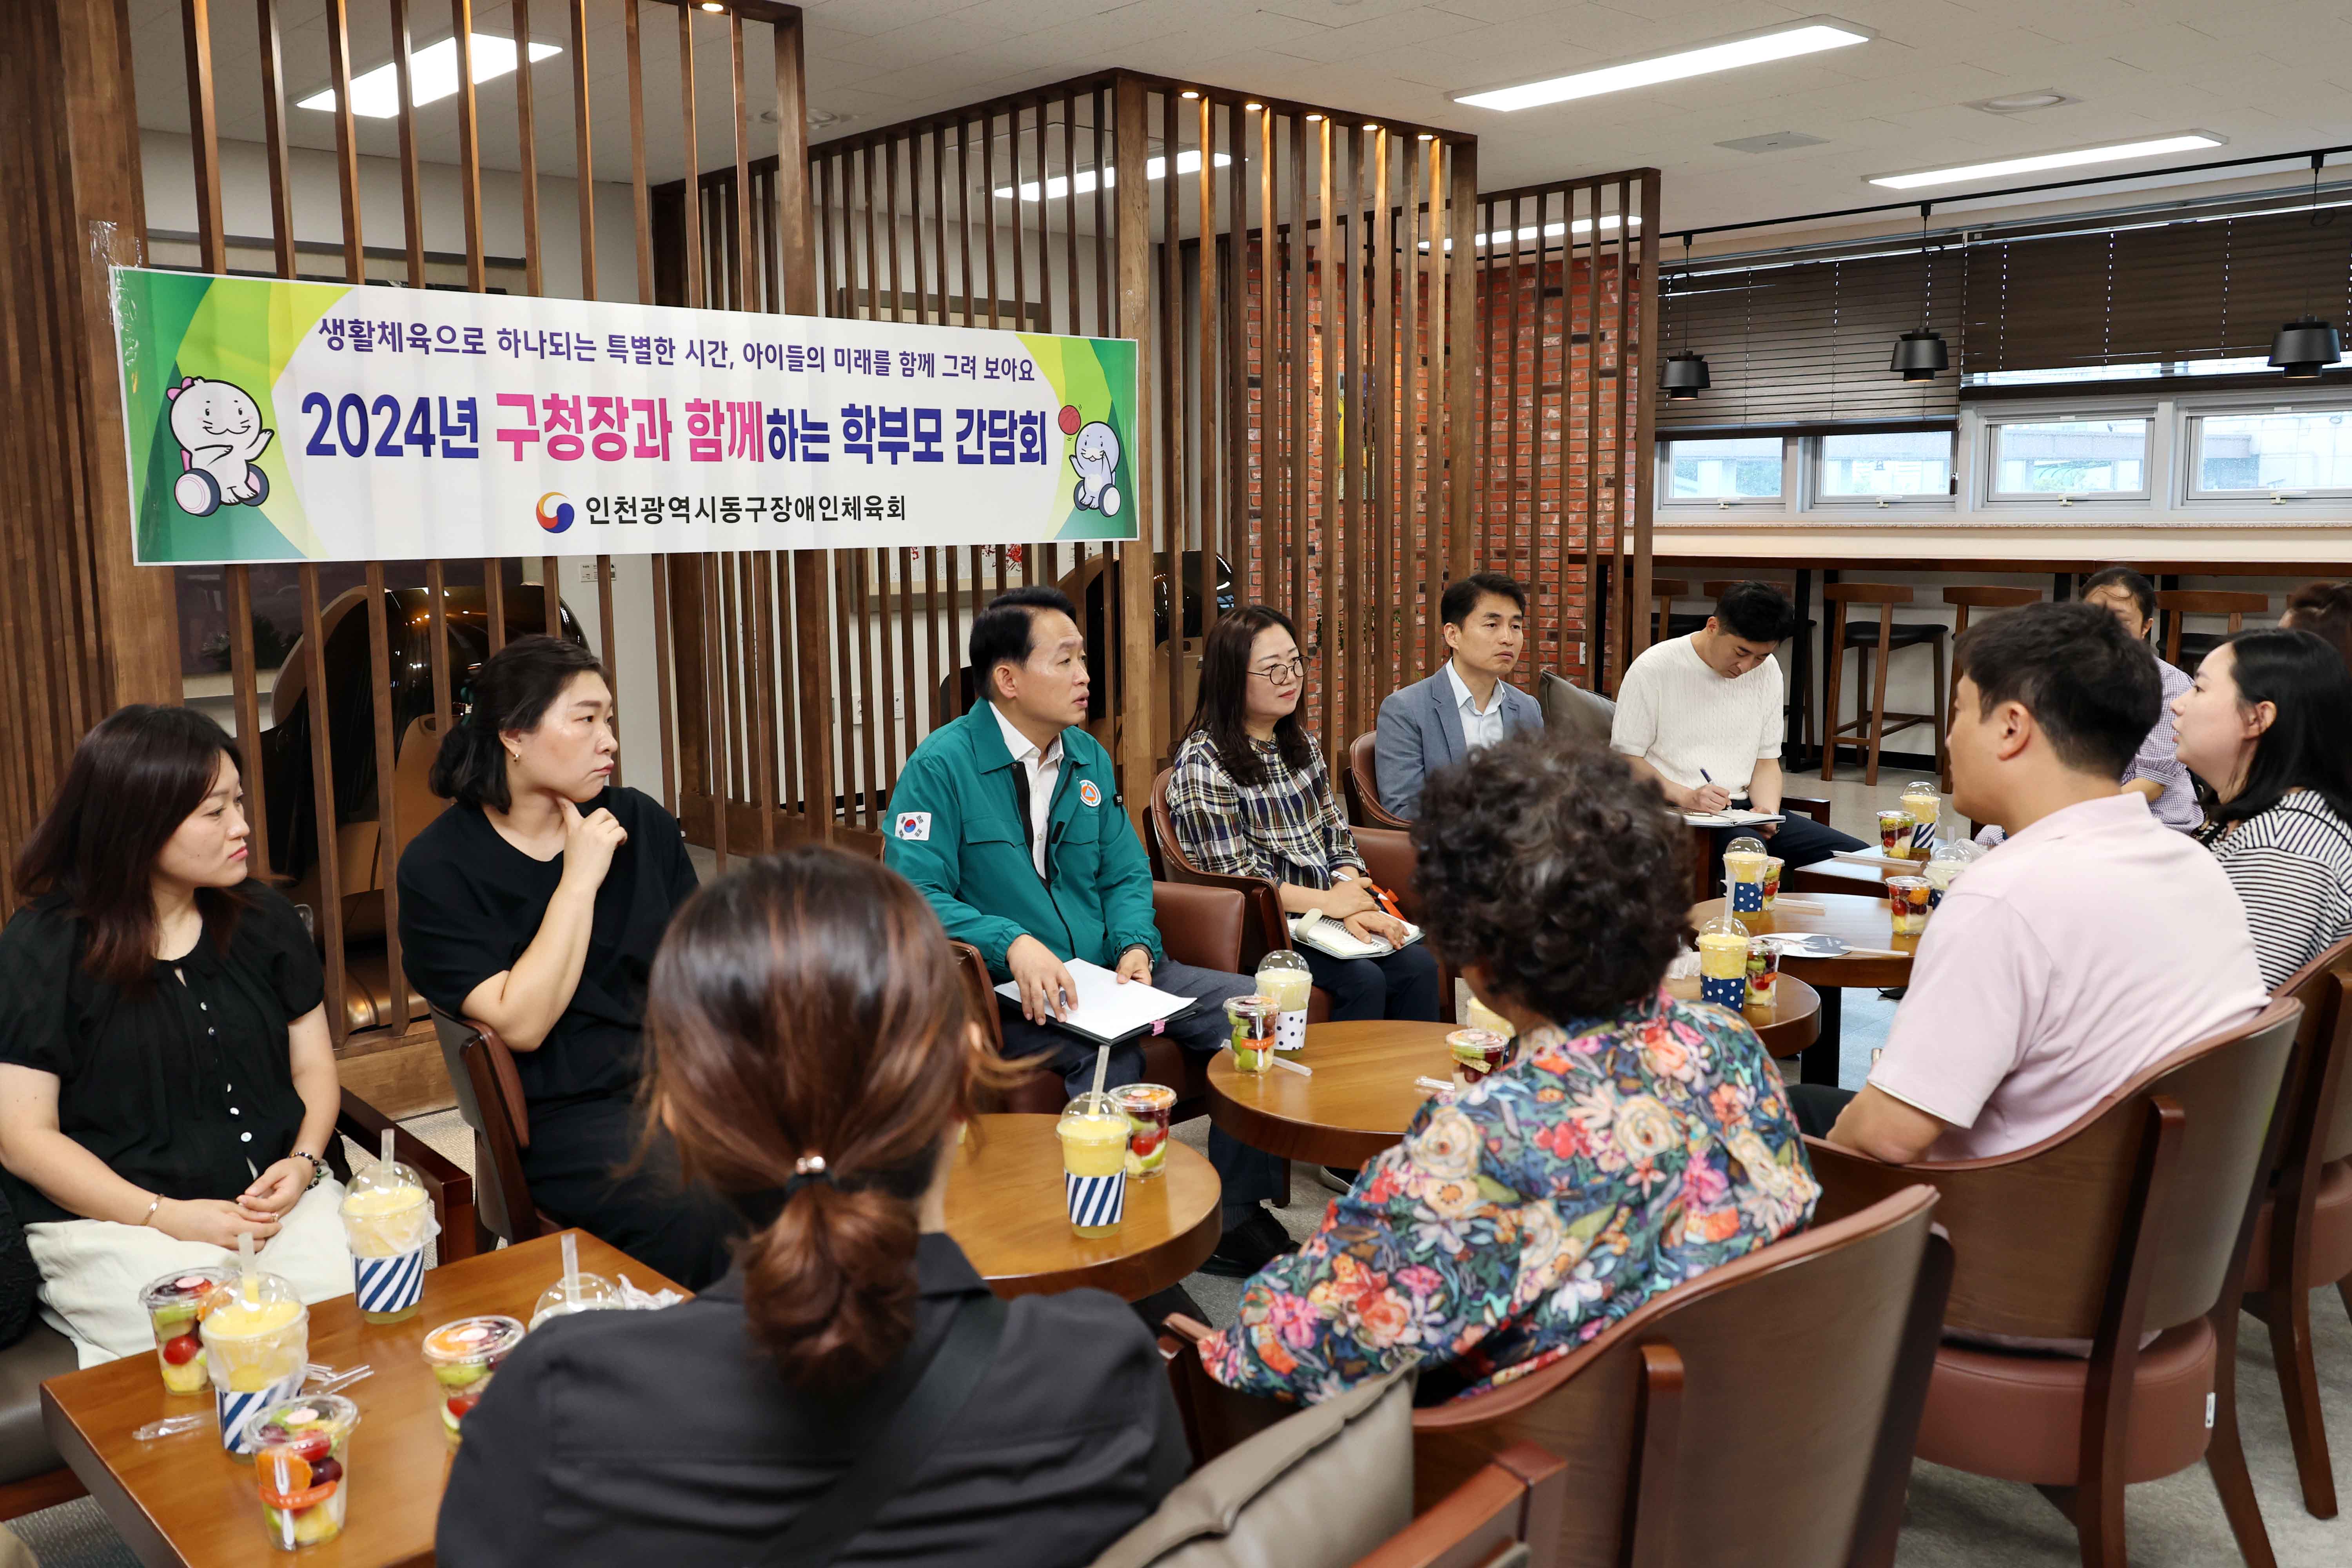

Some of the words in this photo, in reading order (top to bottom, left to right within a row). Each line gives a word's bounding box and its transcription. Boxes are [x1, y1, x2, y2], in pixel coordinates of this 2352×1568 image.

[318, 318, 486, 355] 생활체육으로
[497, 328, 597, 362] 하나되는
[606, 334, 675, 366] 특별한
[685, 339, 734, 370] 시간,
[743, 343, 825, 373] 아이들의
[834, 348, 891, 376] 미래를
[899, 351, 935, 378] 함께
[942, 353, 976, 380] 그려
[984, 357, 1035, 382] 보아요
[301, 392, 479, 459] 2024년
[496, 393, 672, 462] 구청장과
[685, 398, 830, 463] 함께하는
[841, 403, 944, 465] 학부모
[956, 408, 1047, 466] 간담회
[586, 495, 905, 524] 인천광역시동구장애인체육회
